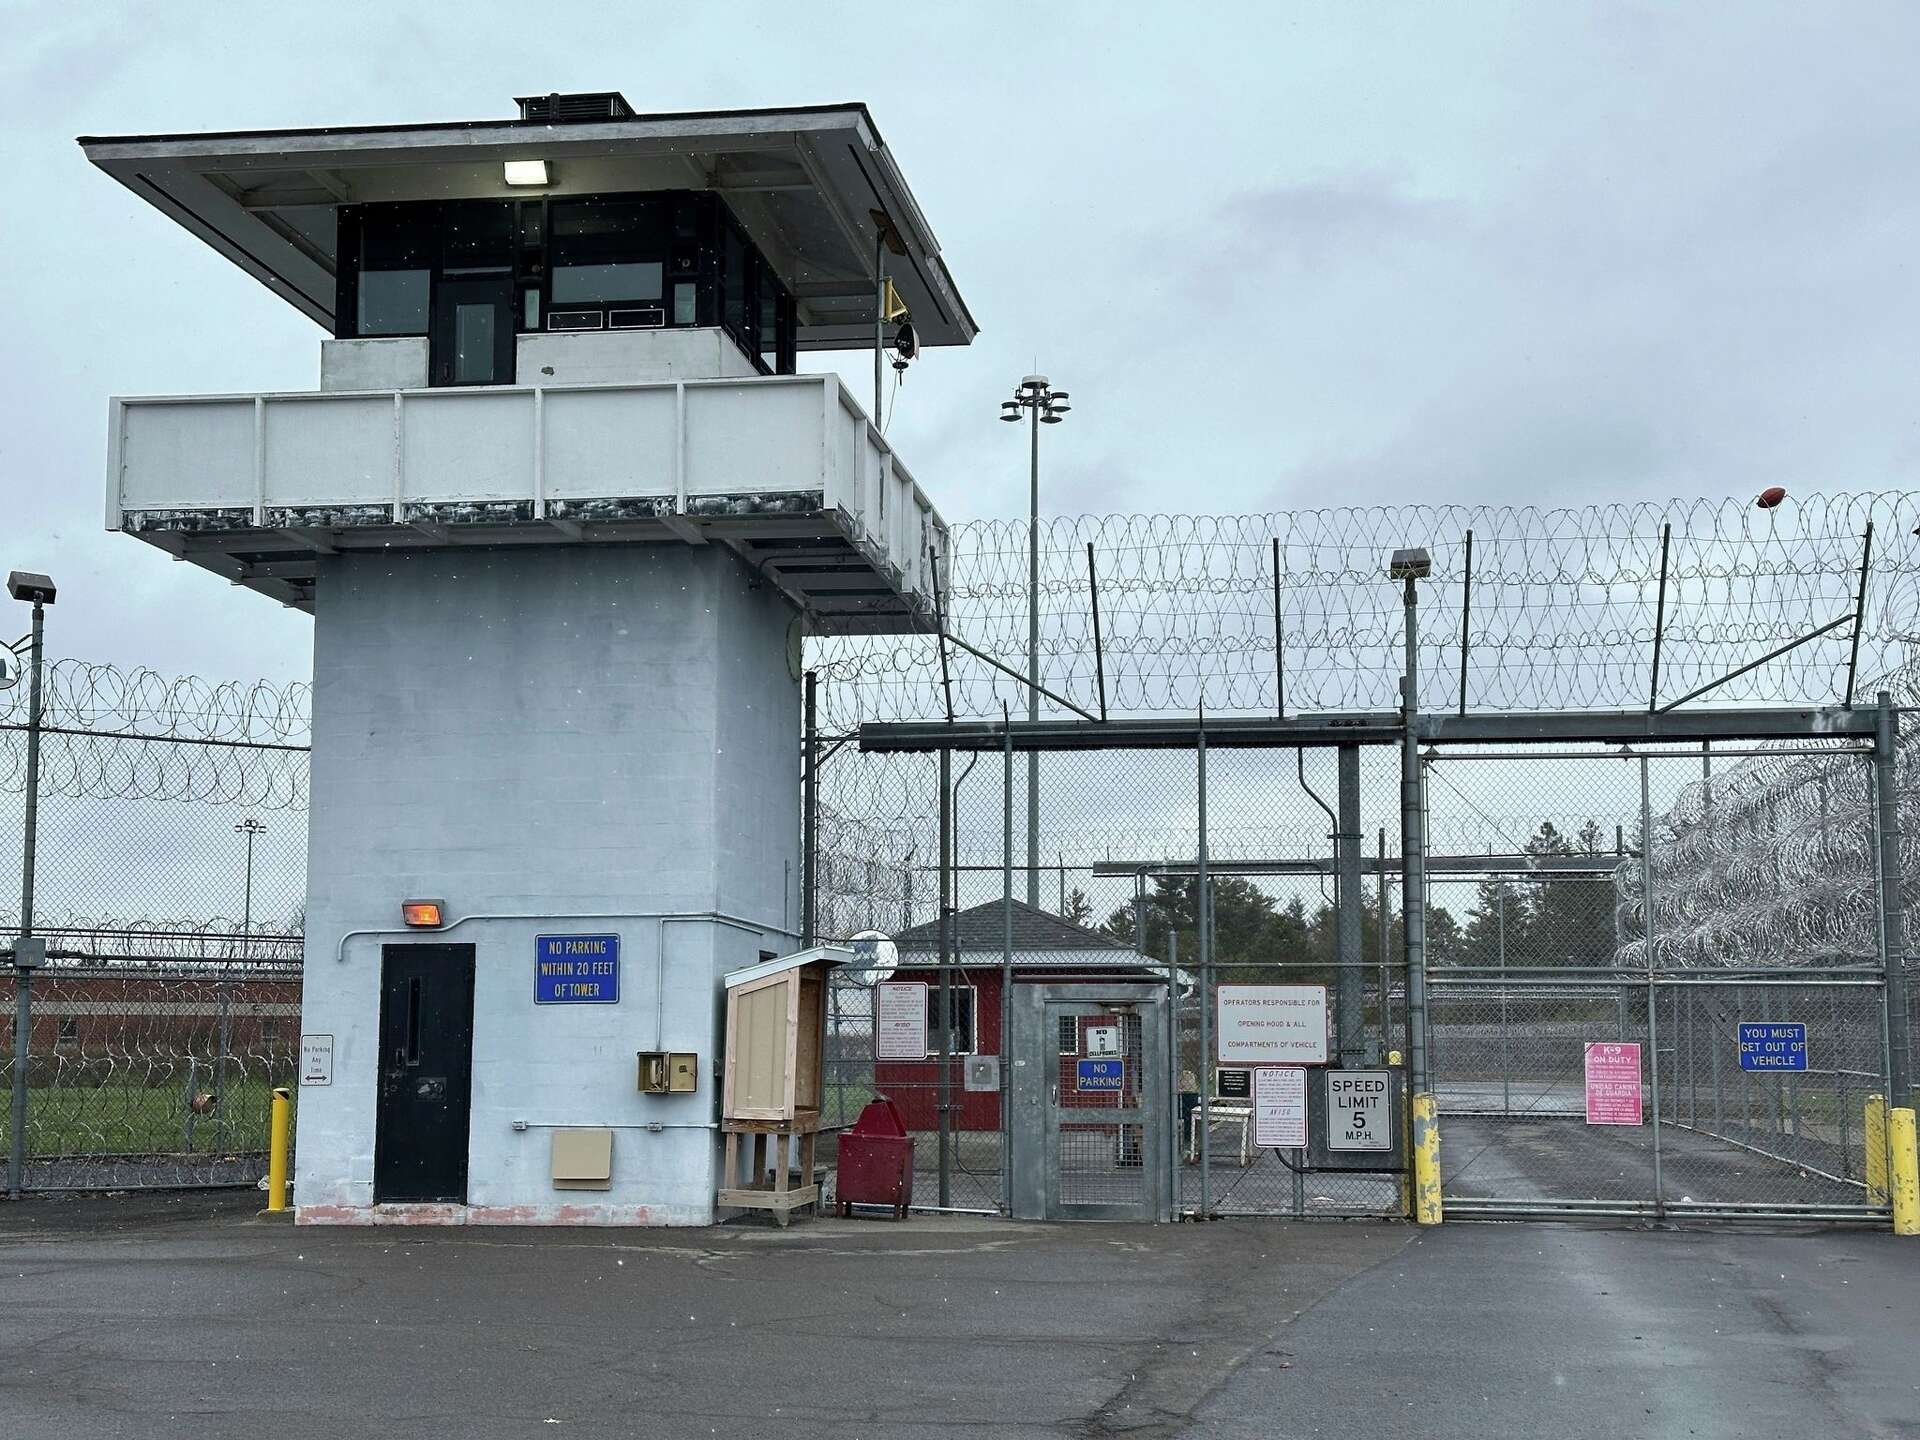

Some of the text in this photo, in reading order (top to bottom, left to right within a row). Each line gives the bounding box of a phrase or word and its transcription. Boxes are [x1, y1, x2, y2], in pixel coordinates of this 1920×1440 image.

[549, 940, 607, 955] NO PARKING
[541, 961, 614, 976] WITHIN 20 FEET
[554, 983, 600, 997] OF TOWER
[1237, 1020, 1265, 1028] OPENING
[1266, 1020, 1284, 1028] HOOD
[1293, 1020, 1307, 1028] ALL
[1744, 1028, 1800, 1038] YOU MUST
[312, 1046, 330, 1054] Parking
[1291, 1041, 1317, 1049] VEHICLE
[1741, 1041, 1805, 1052] GET OUT OF
[1603, 1046, 1622, 1055] K-9
[1593, 1055, 1632, 1064] ON DUTY
[1751, 1056, 1796, 1066] VEHICLE
[1093, 1063, 1108, 1073] NO
[1263, 1070, 1297, 1078] NOTICE
[1080, 1076, 1121, 1087] PARKING
[1332, 1080, 1385, 1092] SPEED
[1338, 1096, 1379, 1108] LIMIT
[1352, 1111, 1366, 1129] 5
